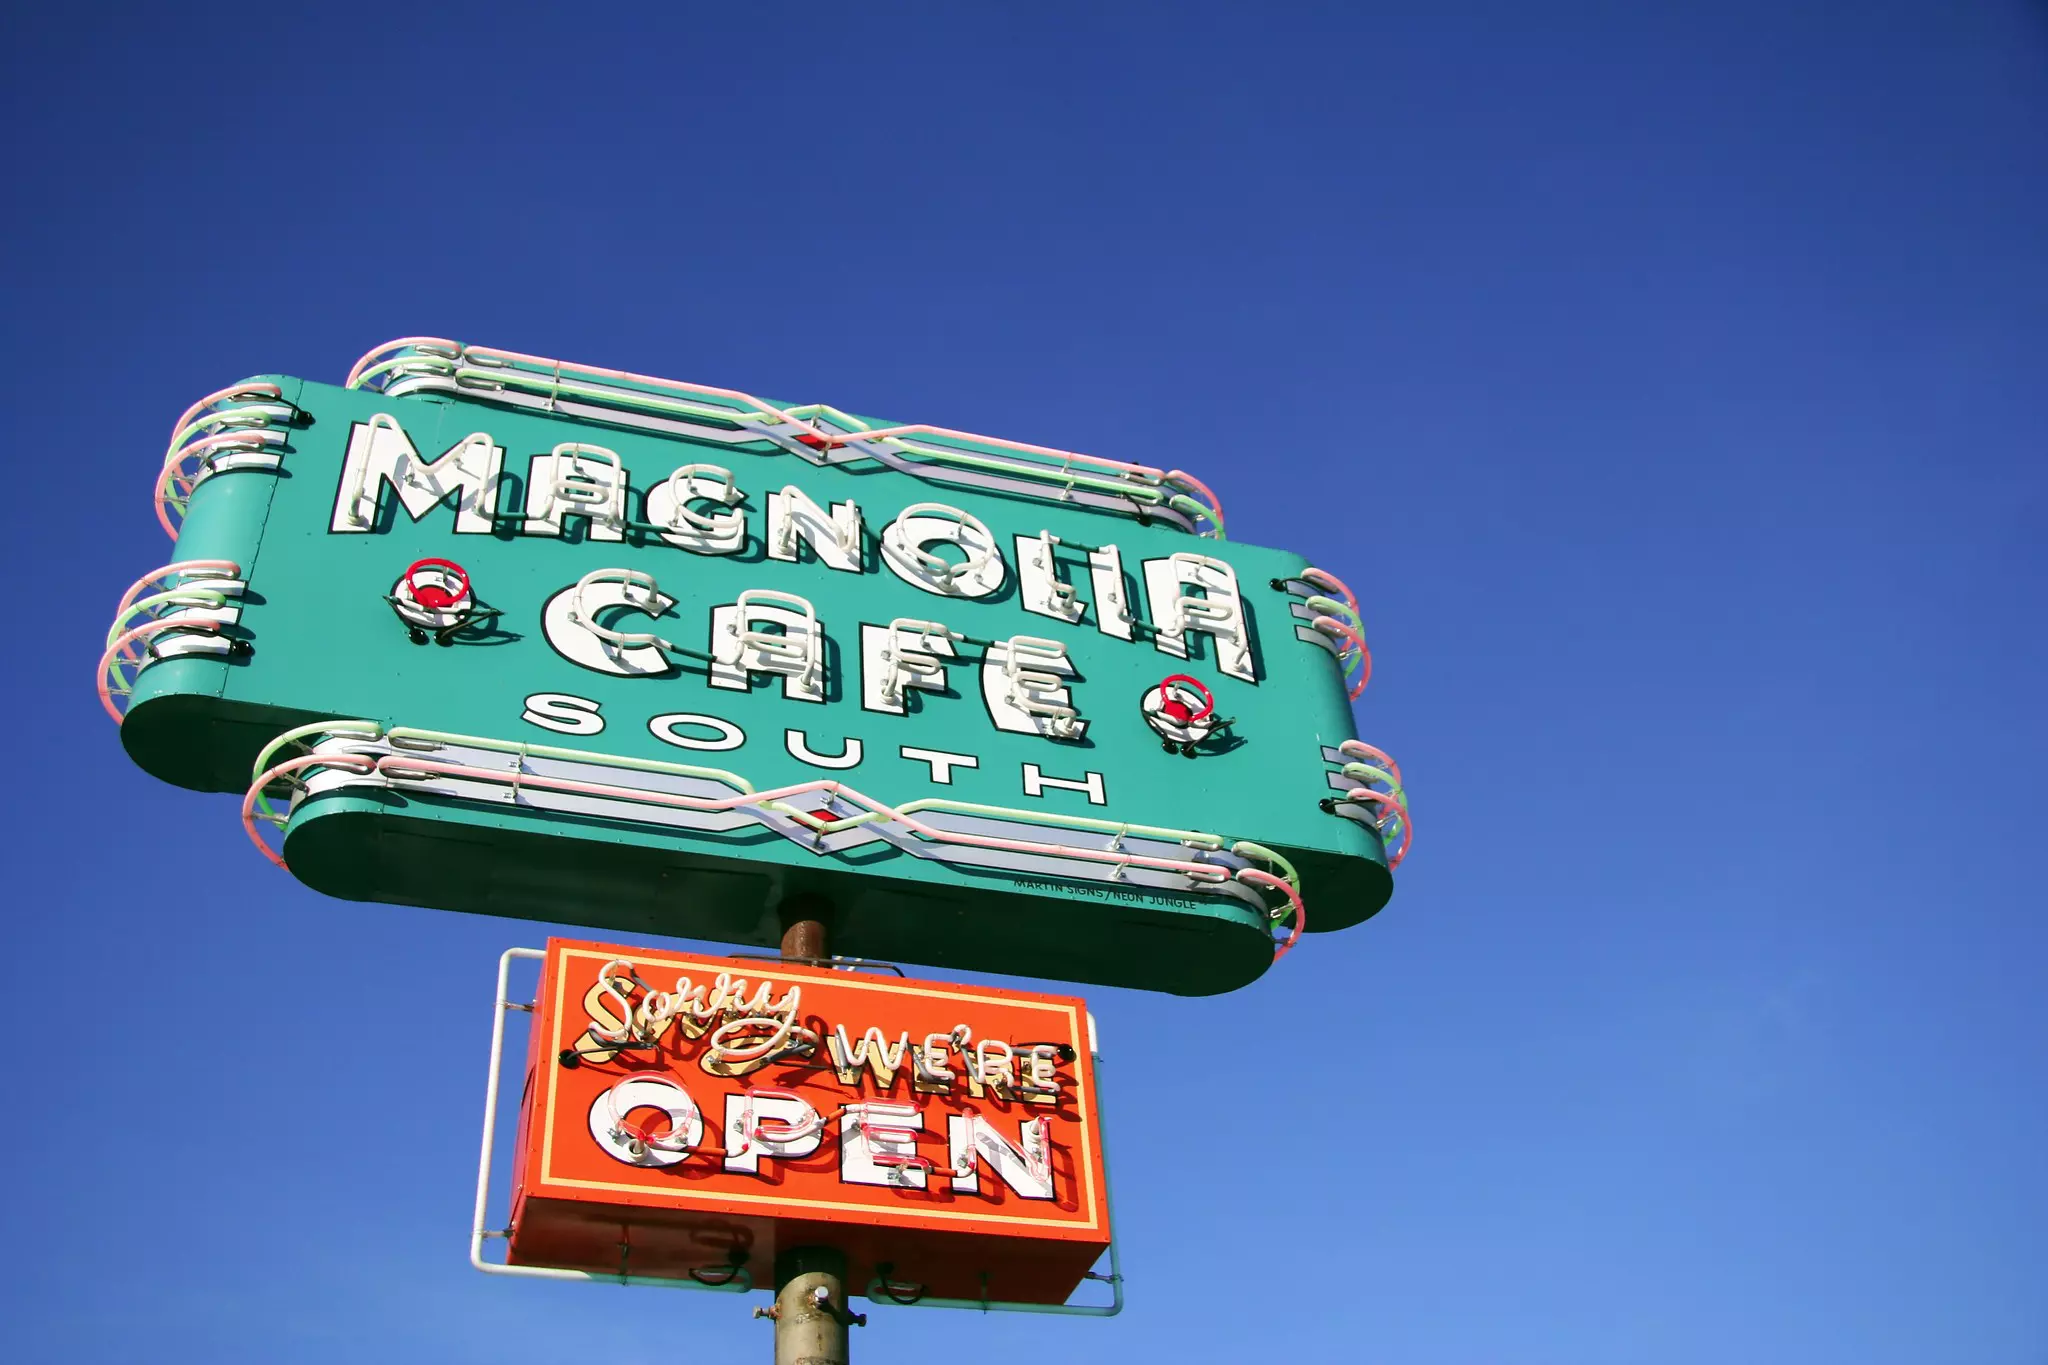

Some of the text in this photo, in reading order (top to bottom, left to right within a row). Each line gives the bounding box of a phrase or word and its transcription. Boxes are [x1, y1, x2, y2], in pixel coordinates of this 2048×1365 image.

[328, 413, 1258, 683] MAGNOLIA
[540, 568, 1090, 742] CAFE
[521, 692, 1107, 805] SOUTH
[1013, 879, 1063, 892] MARTIN
[1149, 896, 1197, 910] JUNGLE
[573, 959, 819, 1077] Sorry
[587, 1073, 1057, 1200] OPEN
